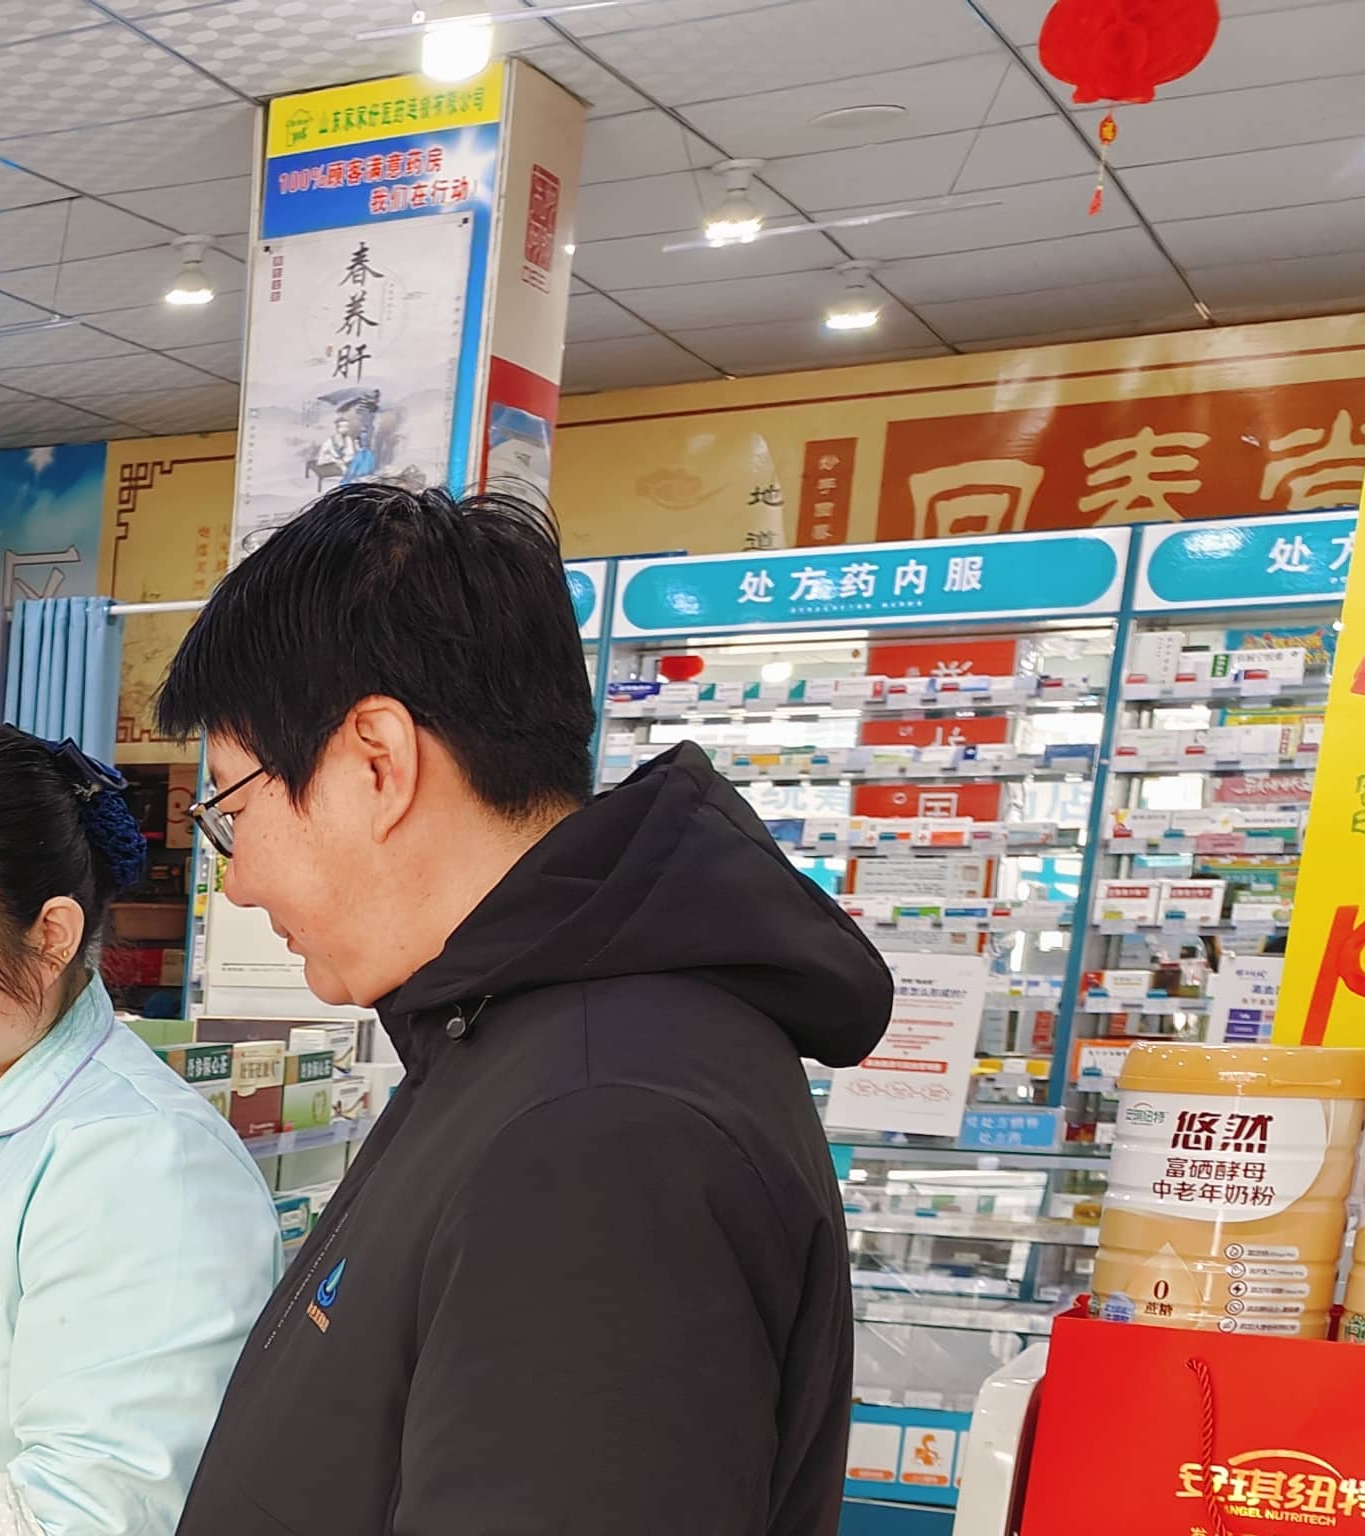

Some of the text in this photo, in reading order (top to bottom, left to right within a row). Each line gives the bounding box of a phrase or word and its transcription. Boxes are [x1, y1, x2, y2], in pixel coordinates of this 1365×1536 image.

[278, 146, 444, 195] 100%顾客满意药房
[331, 240, 385, 382] 春养肝
[737, 556, 986, 605] 处方药内服
[1171, 1110, 1274, 1154] 悠然
[1166, 1157, 1267, 1184] 富硒酵母
[1152, 1179, 1276, 1207] 中老年奶粉
[1265, 1507, 1336, 1527] NUTRITECH
